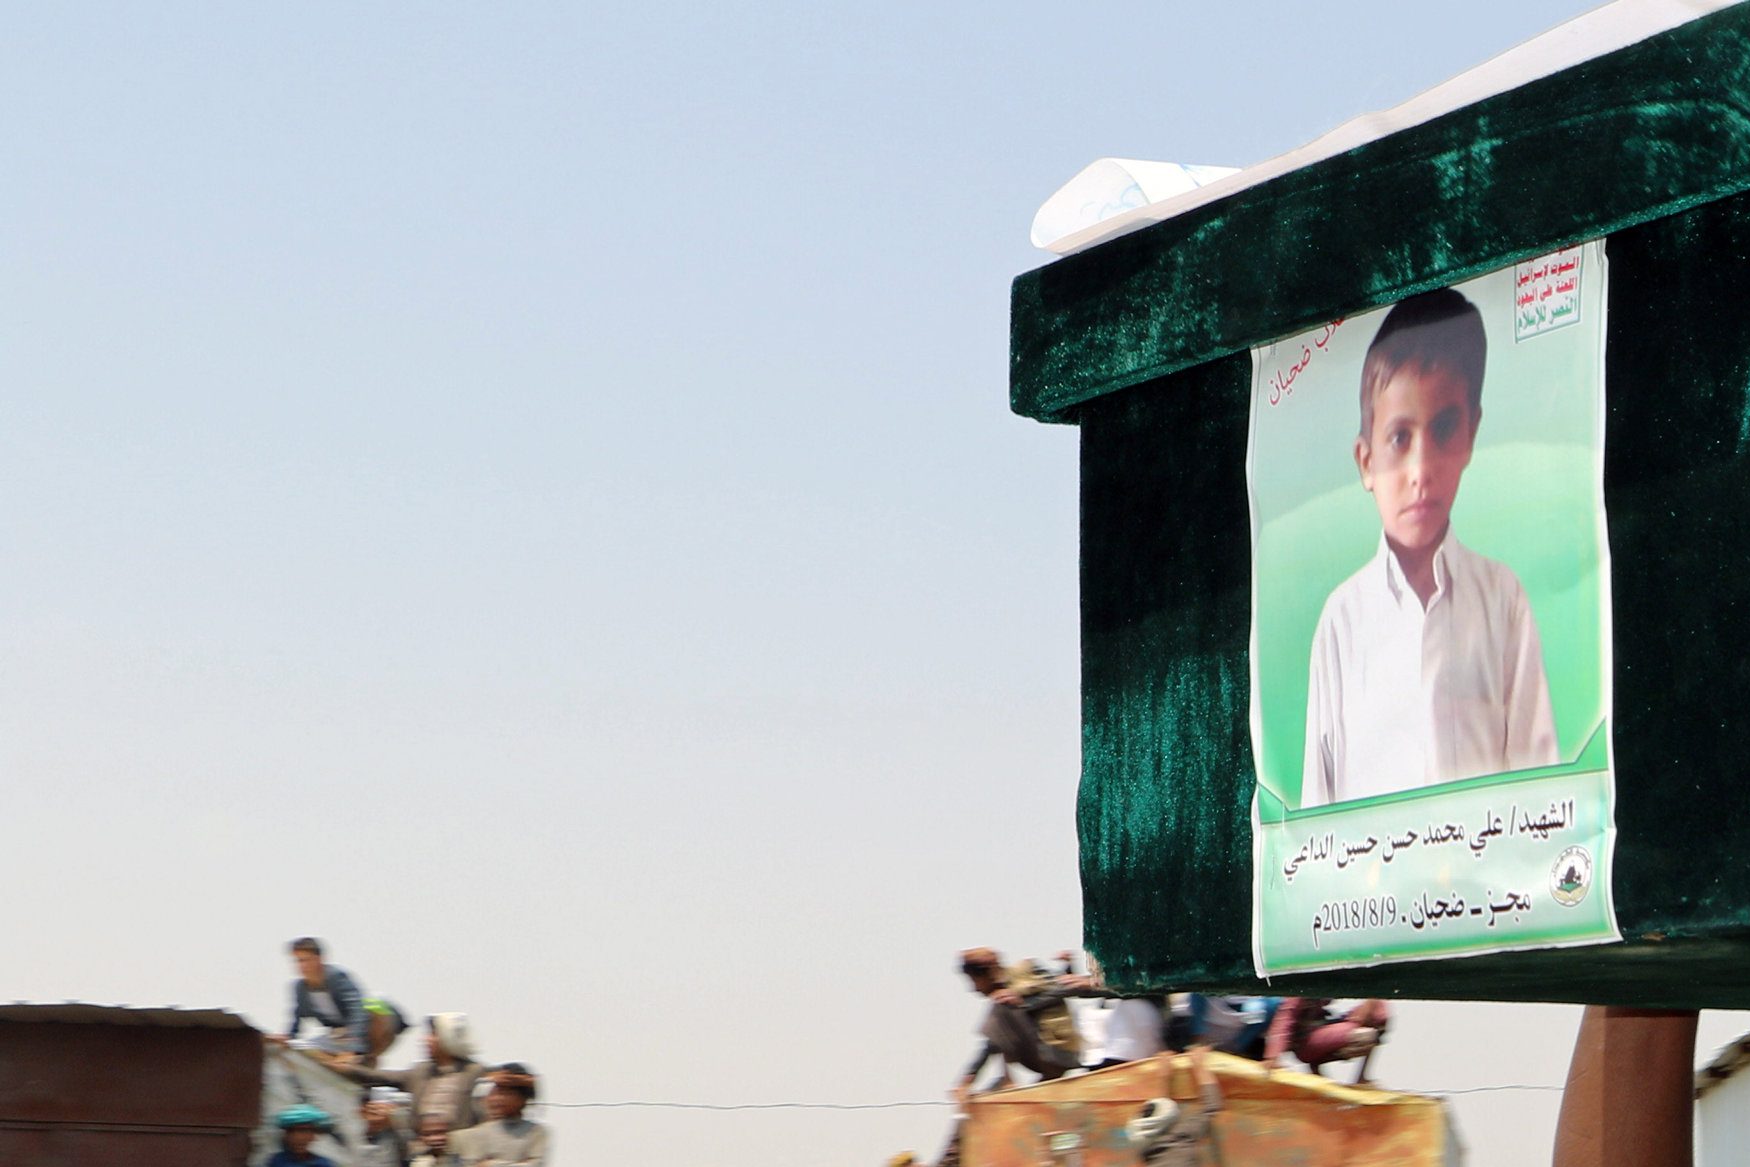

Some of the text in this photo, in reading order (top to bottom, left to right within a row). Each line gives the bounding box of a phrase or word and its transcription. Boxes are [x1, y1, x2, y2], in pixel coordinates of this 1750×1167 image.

[1382, 830, 1419, 863] حسن
[1422, 822, 1465, 844] محمد
[1469, 809, 1503, 858] علي
[1336, 835, 1379, 868] حسين
